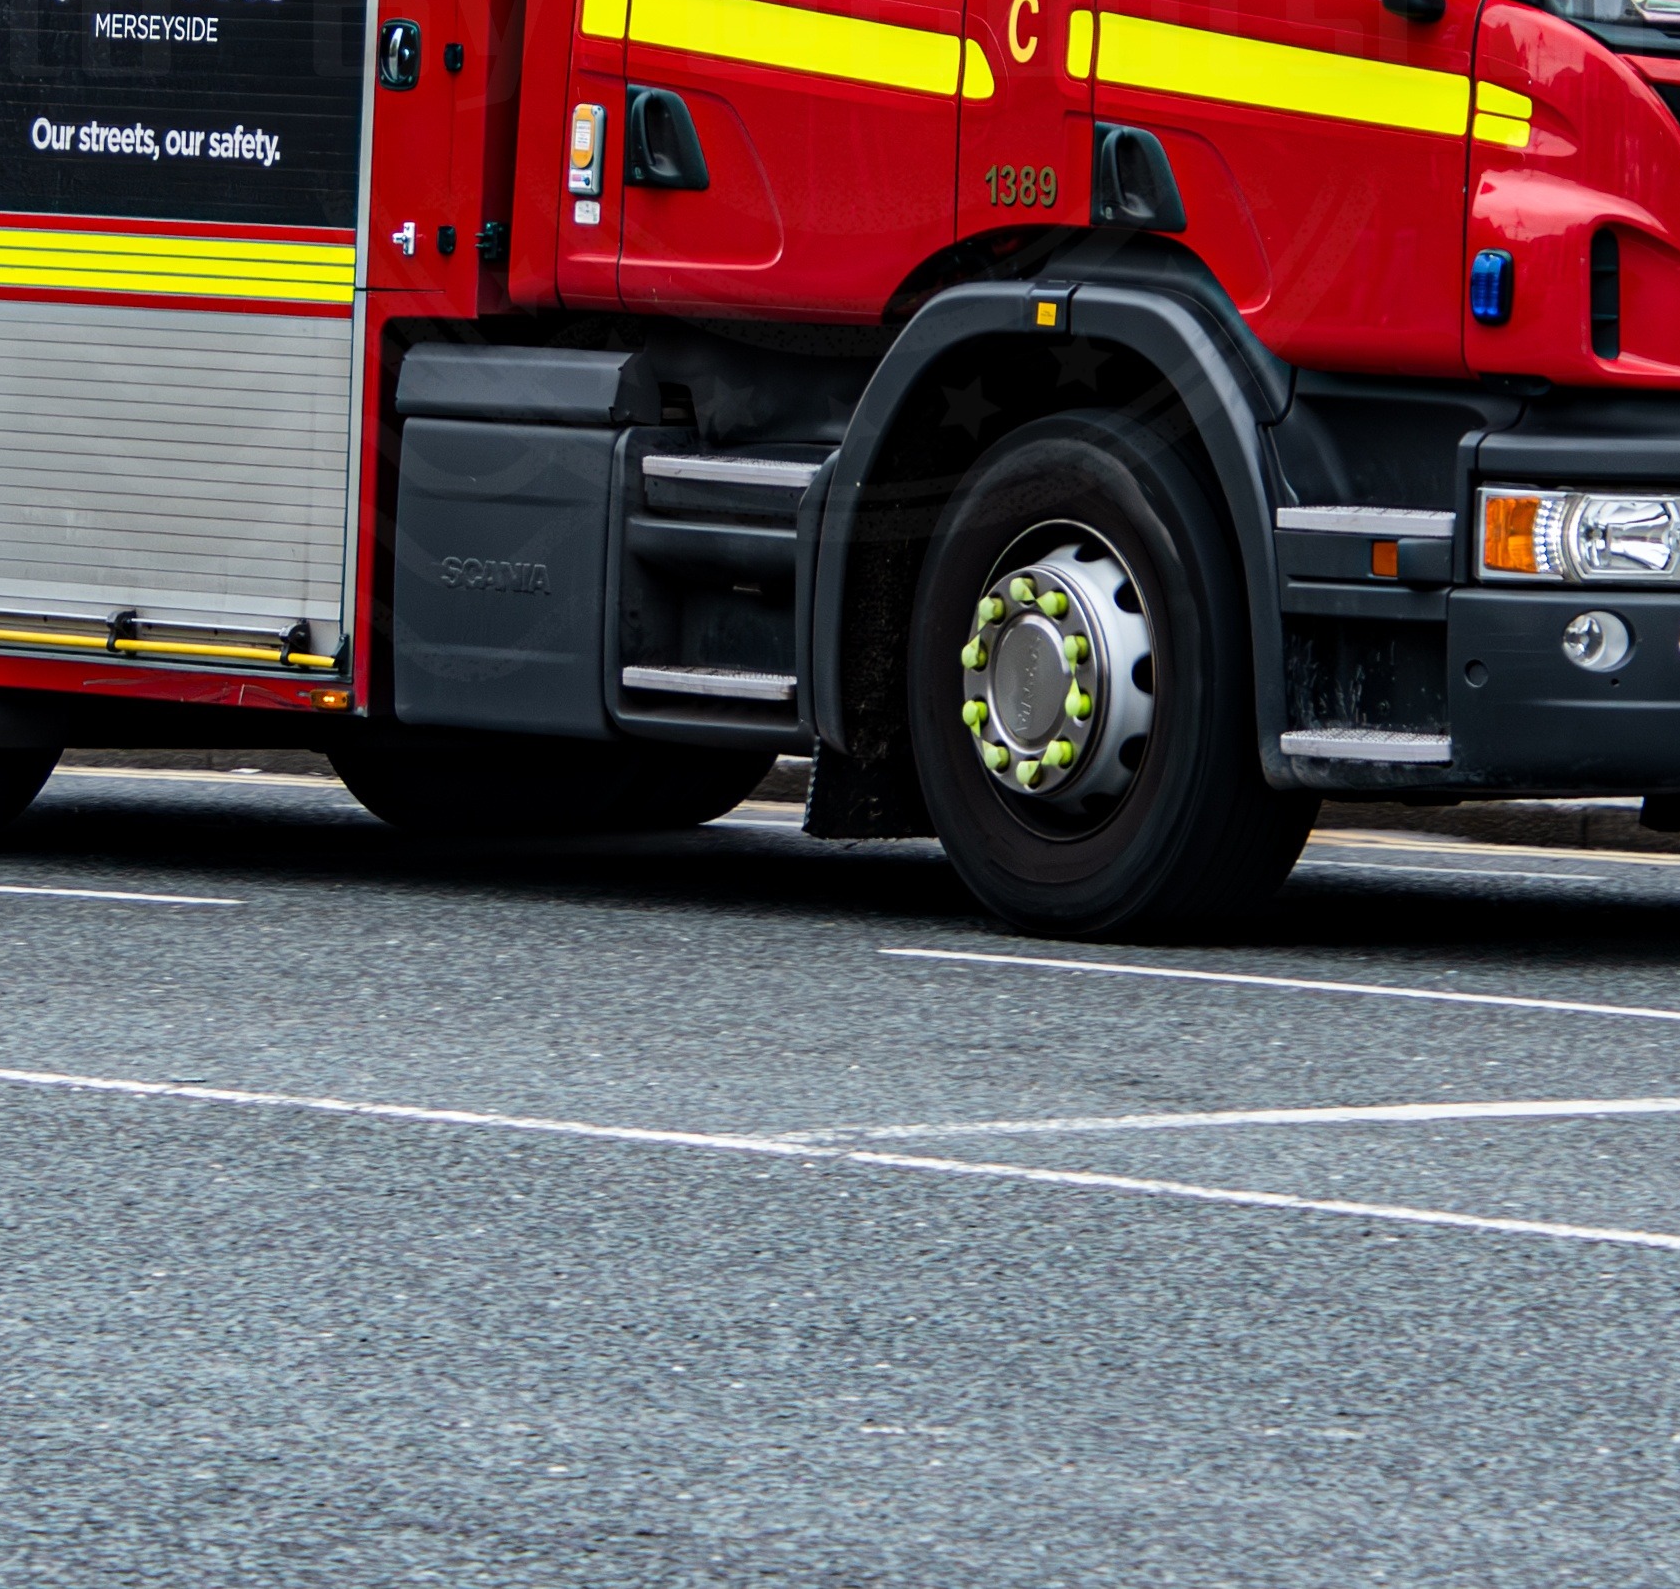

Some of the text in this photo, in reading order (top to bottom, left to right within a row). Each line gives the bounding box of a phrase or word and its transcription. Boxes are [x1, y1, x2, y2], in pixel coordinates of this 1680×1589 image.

[95, 13, 219, 43] MERSEYSIDE
[31, 116, 281, 167] Our streets, our safety.
[985, 164, 1058, 208] 1389
[441, 556, 551, 595] SCANIA
